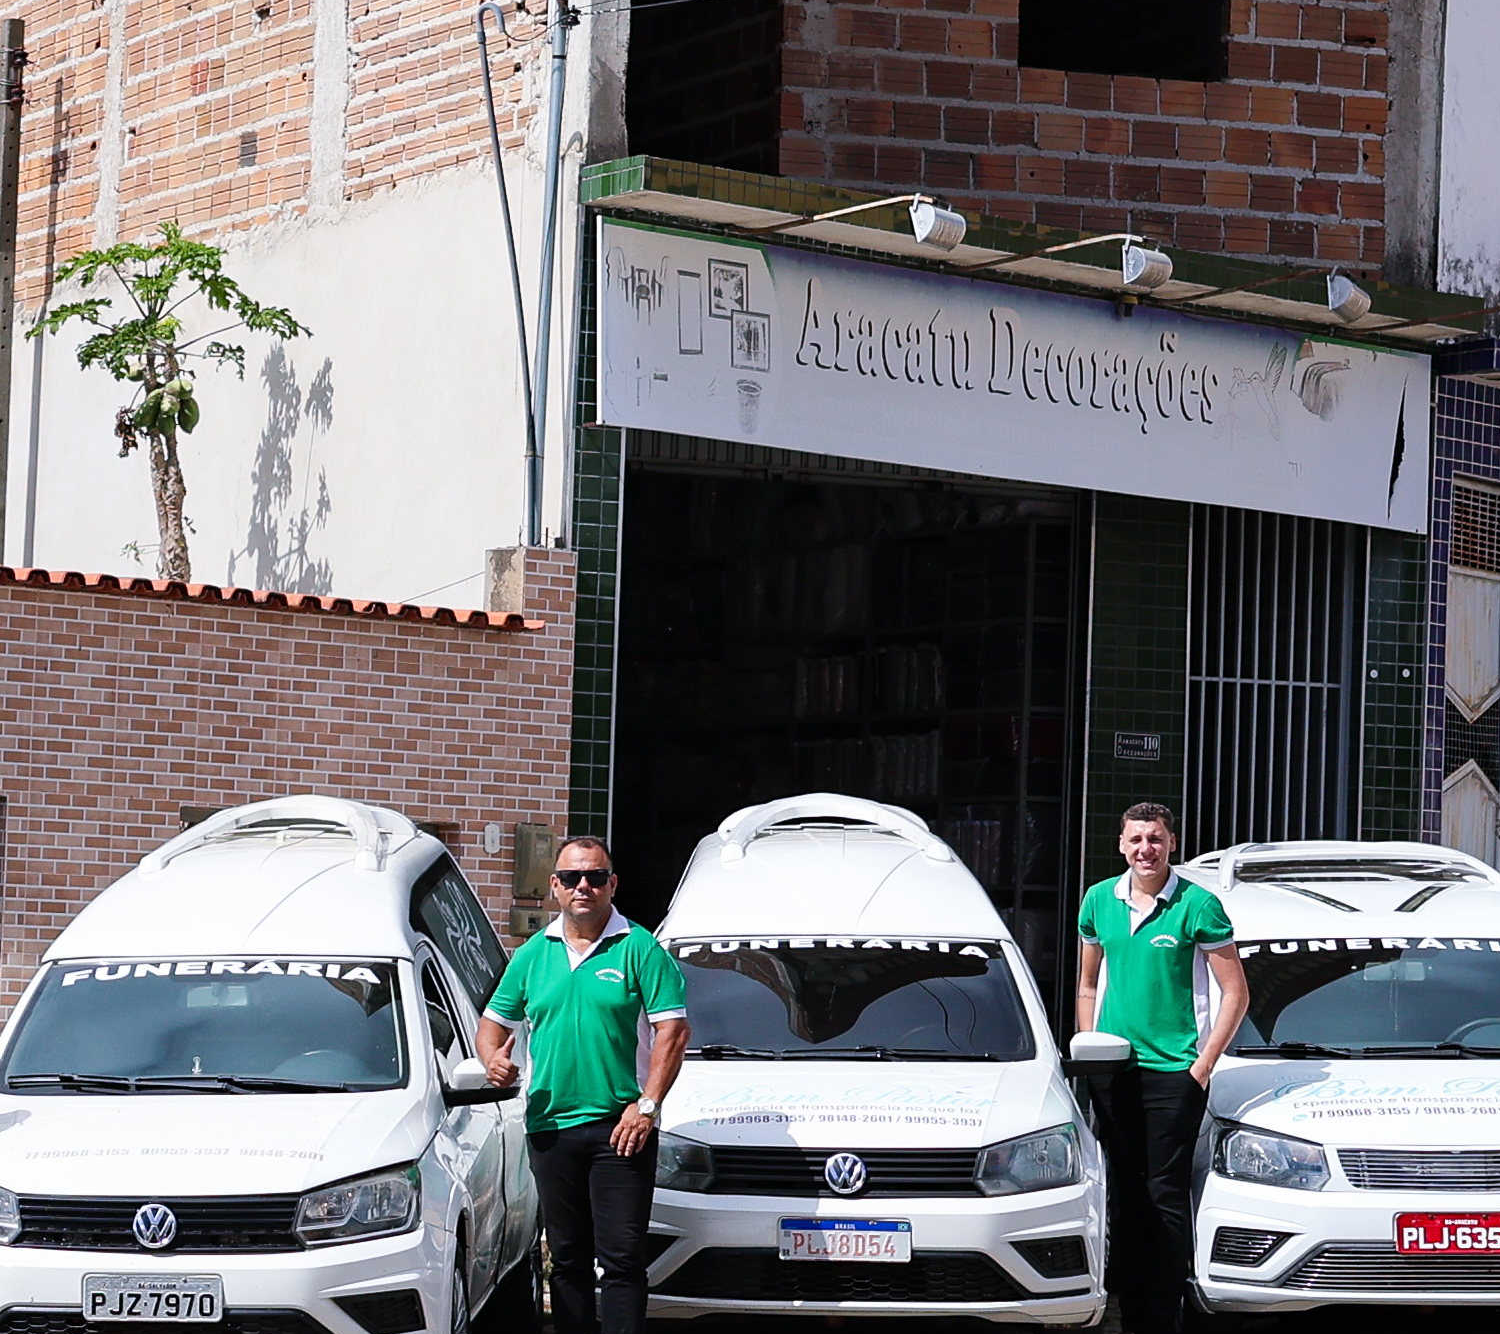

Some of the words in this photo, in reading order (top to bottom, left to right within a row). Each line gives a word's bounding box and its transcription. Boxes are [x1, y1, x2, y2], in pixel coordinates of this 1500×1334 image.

[1144, 736, 1158, 750] 110
[678, 938, 990, 959] FUNERÁRIA
[61, 959, 382, 987] FUNERÁRIA
[684, 1085, 823, 1107] Bom
[843, 1085, 1000, 1108] Pastor
[1272, 1078, 1424, 1104] Bom
[1293, 1095, 1383, 1109] Experiência
[700, 1104, 783, 1114] Experiência
[801, 1103, 901, 1113] transparência
[792, 1232, 897, 1257] PLJ8D54
